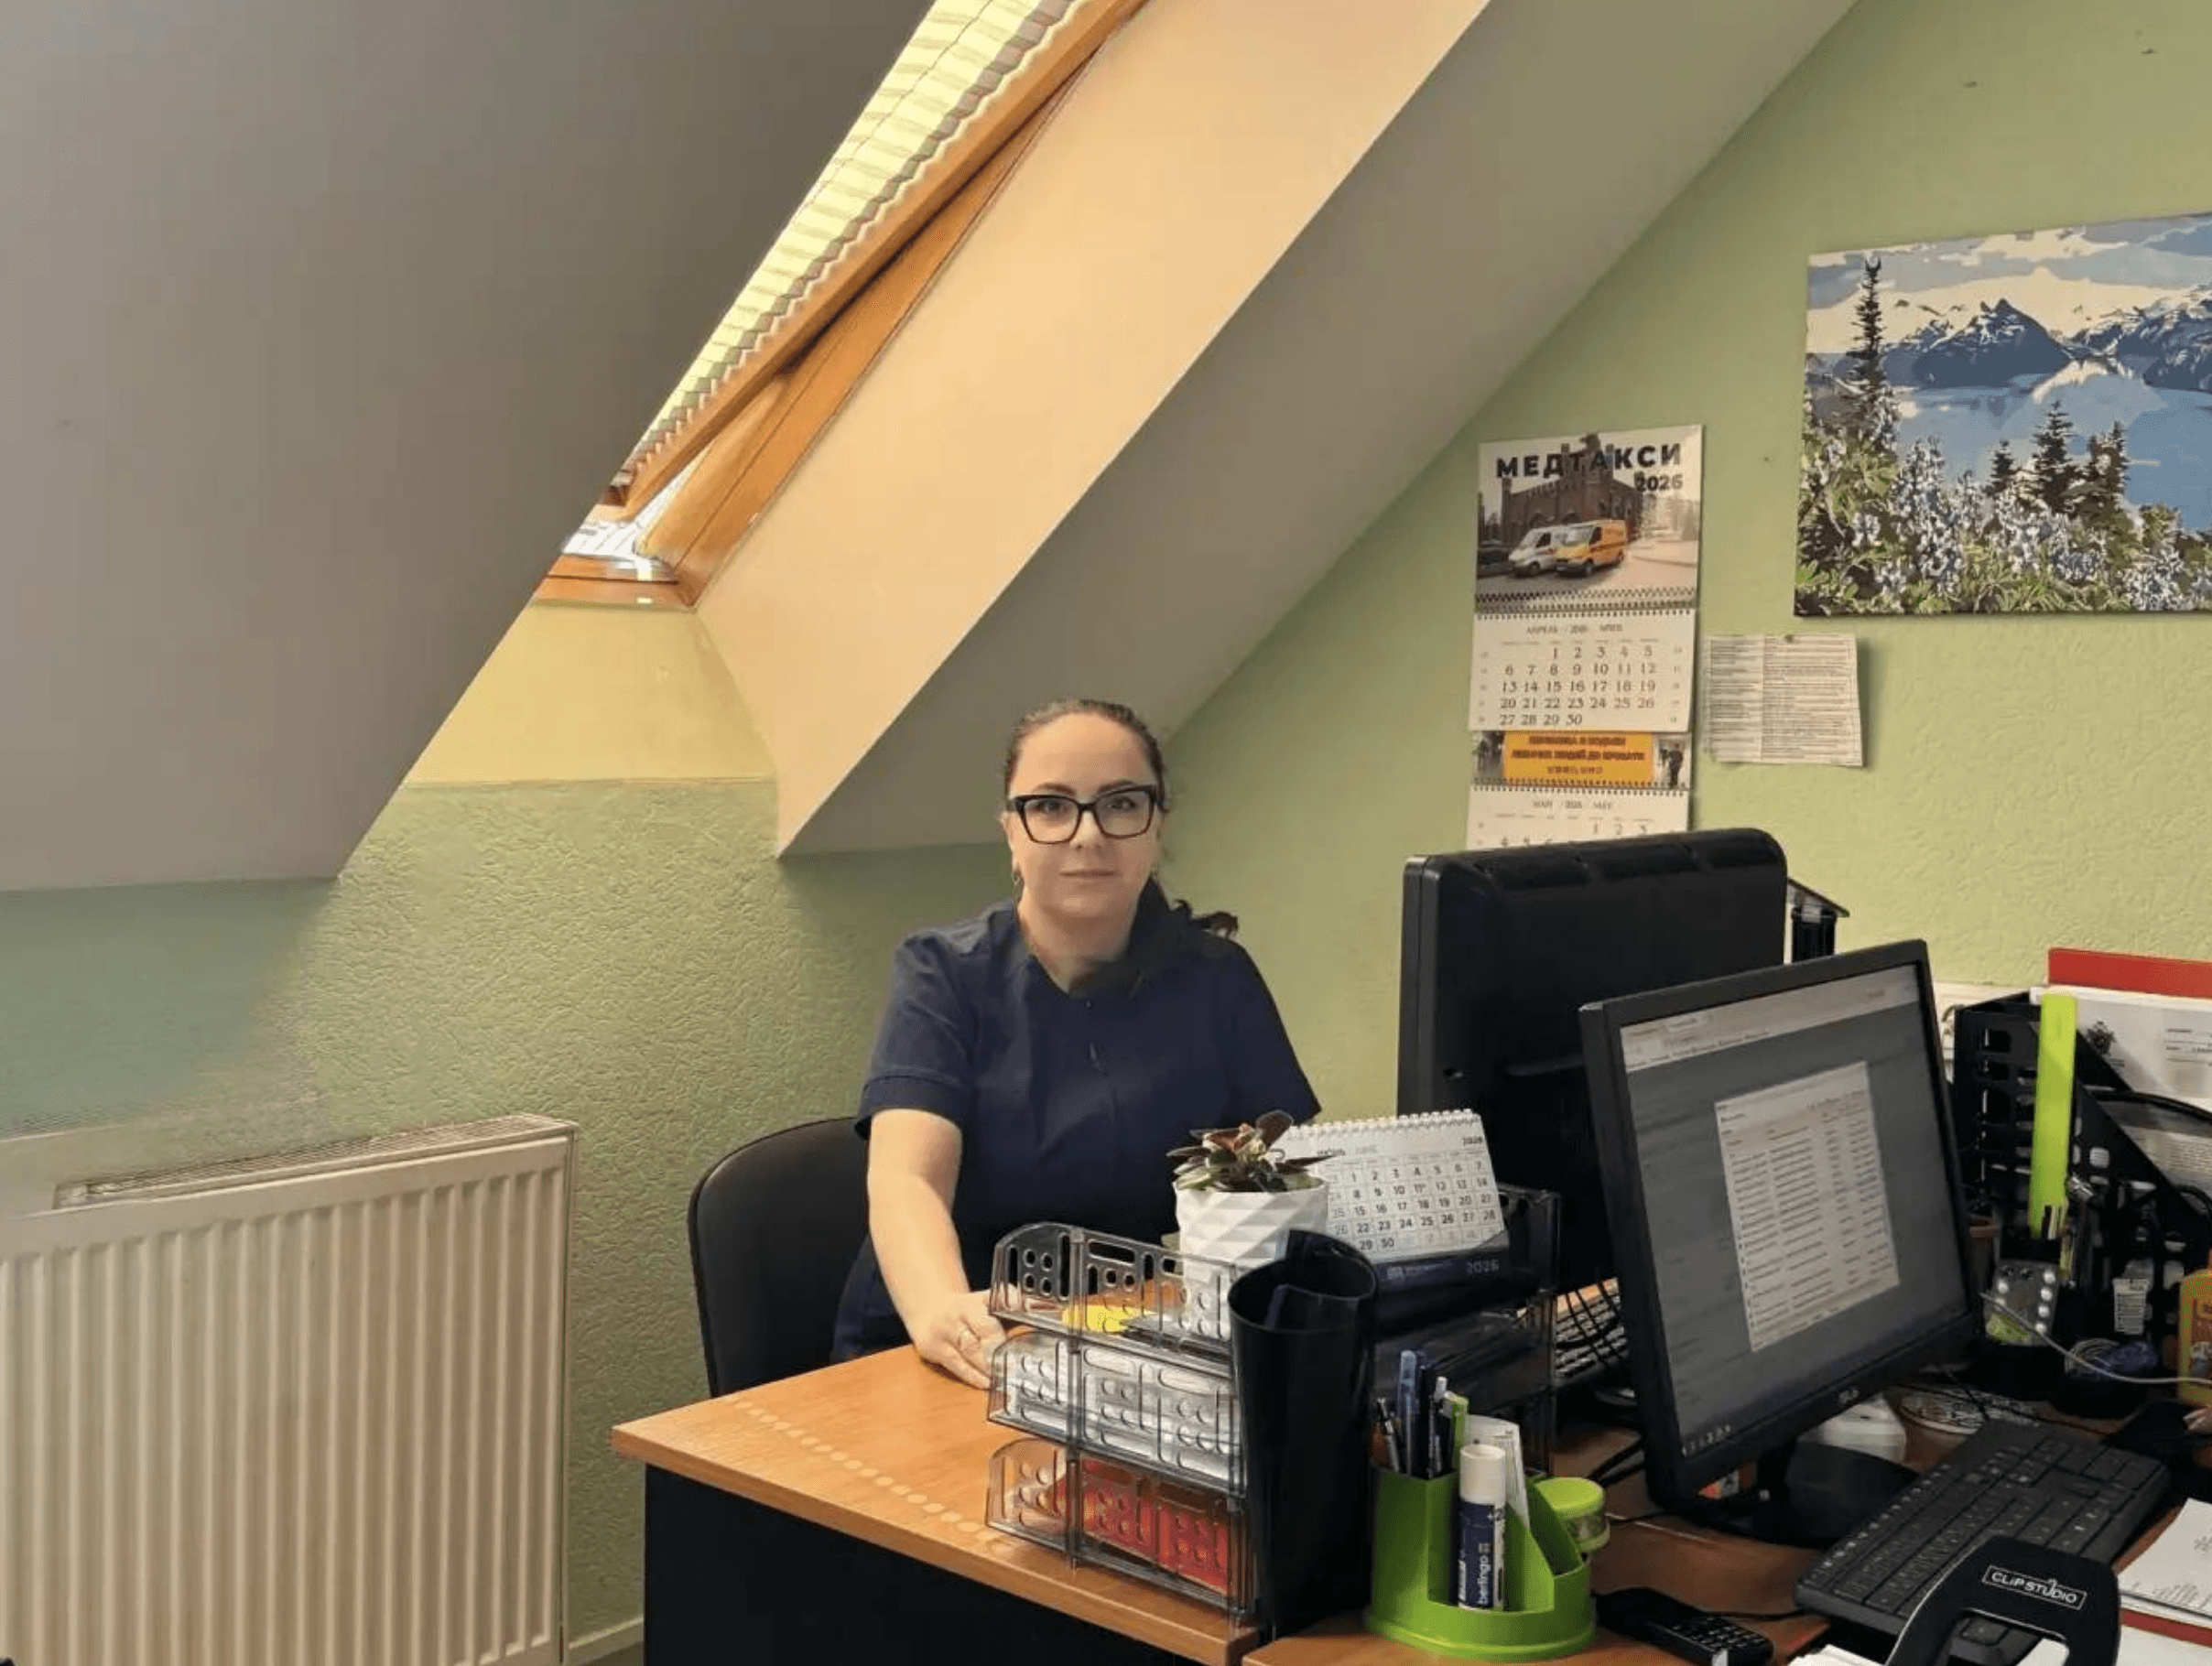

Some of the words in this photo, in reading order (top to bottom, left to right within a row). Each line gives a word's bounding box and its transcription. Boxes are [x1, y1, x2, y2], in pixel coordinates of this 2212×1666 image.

[1496, 443, 1681, 479] МЕДТАКСИ
[1634, 473, 1684, 492] 2026
[1593, 664, 1609, 676] 10
[1618, 664, 1632, 675] 11
[1640, 663, 1656, 675] 12
[1502, 680, 1517, 693] 13
[1524, 681, 1538, 693] 14
[1546, 680, 1562, 693] 15
[1569, 680, 1585, 693] 16
[1593, 680, 1608, 692] 17
[1616, 680, 1632, 693] 18
[1640, 679, 1656, 692] 19
[1500, 698, 1516, 709] 20
[1522, 698, 1537, 709] 21
[1544, 698, 1560, 709] 22
[1567, 698, 1584, 709] 23
[1589, 698, 1606, 709] 24
[1614, 698, 1631, 709] 25
[1637, 697, 1654, 709] 26
[1500, 714, 1515, 725] 27
[1521, 714, 1537, 725] 28
[1543, 714, 1560, 725] 29
[1566, 714, 1582, 725] 30
[1393, 1185, 1405, 1195] 10
[1415, 1184, 1426, 1193] 11
[1436, 1182, 1447, 1191] 12
[1457, 1180, 1468, 1189] 13
[1477, 1177, 1488, 1187] 14
[1355, 1206, 1366, 1216] 15
[1376, 1204, 1387, 1214] 16
[1397, 1202, 1407, 1211] 17
[1419, 1199, 1429, 1209] 18
[1439, 1197, 1450, 1207] 19
[1459, 1195, 1472, 1206] 20
[1480, 1194, 1491, 1204] 21
[1357, 1223, 1369, 1233] 22
[1378, 1221, 1391, 1231] 23
[1400, 1218, 1412, 1228] 24
[1421, 1216, 1434, 1226] 25
[1441, 1214, 1454, 1224] 26
[1463, 1212, 1474, 1222] 27
[1483, 1210, 1496, 1220] 28
[1359, 1239, 1373, 1250] 29
[1381, 1237, 1394, 1248] 30
[1477, 1555, 1491, 1605] berlingo
[1991, 1572, 2023, 1586] CLIP
[2024, 1578, 2076, 1603] STUDIO
